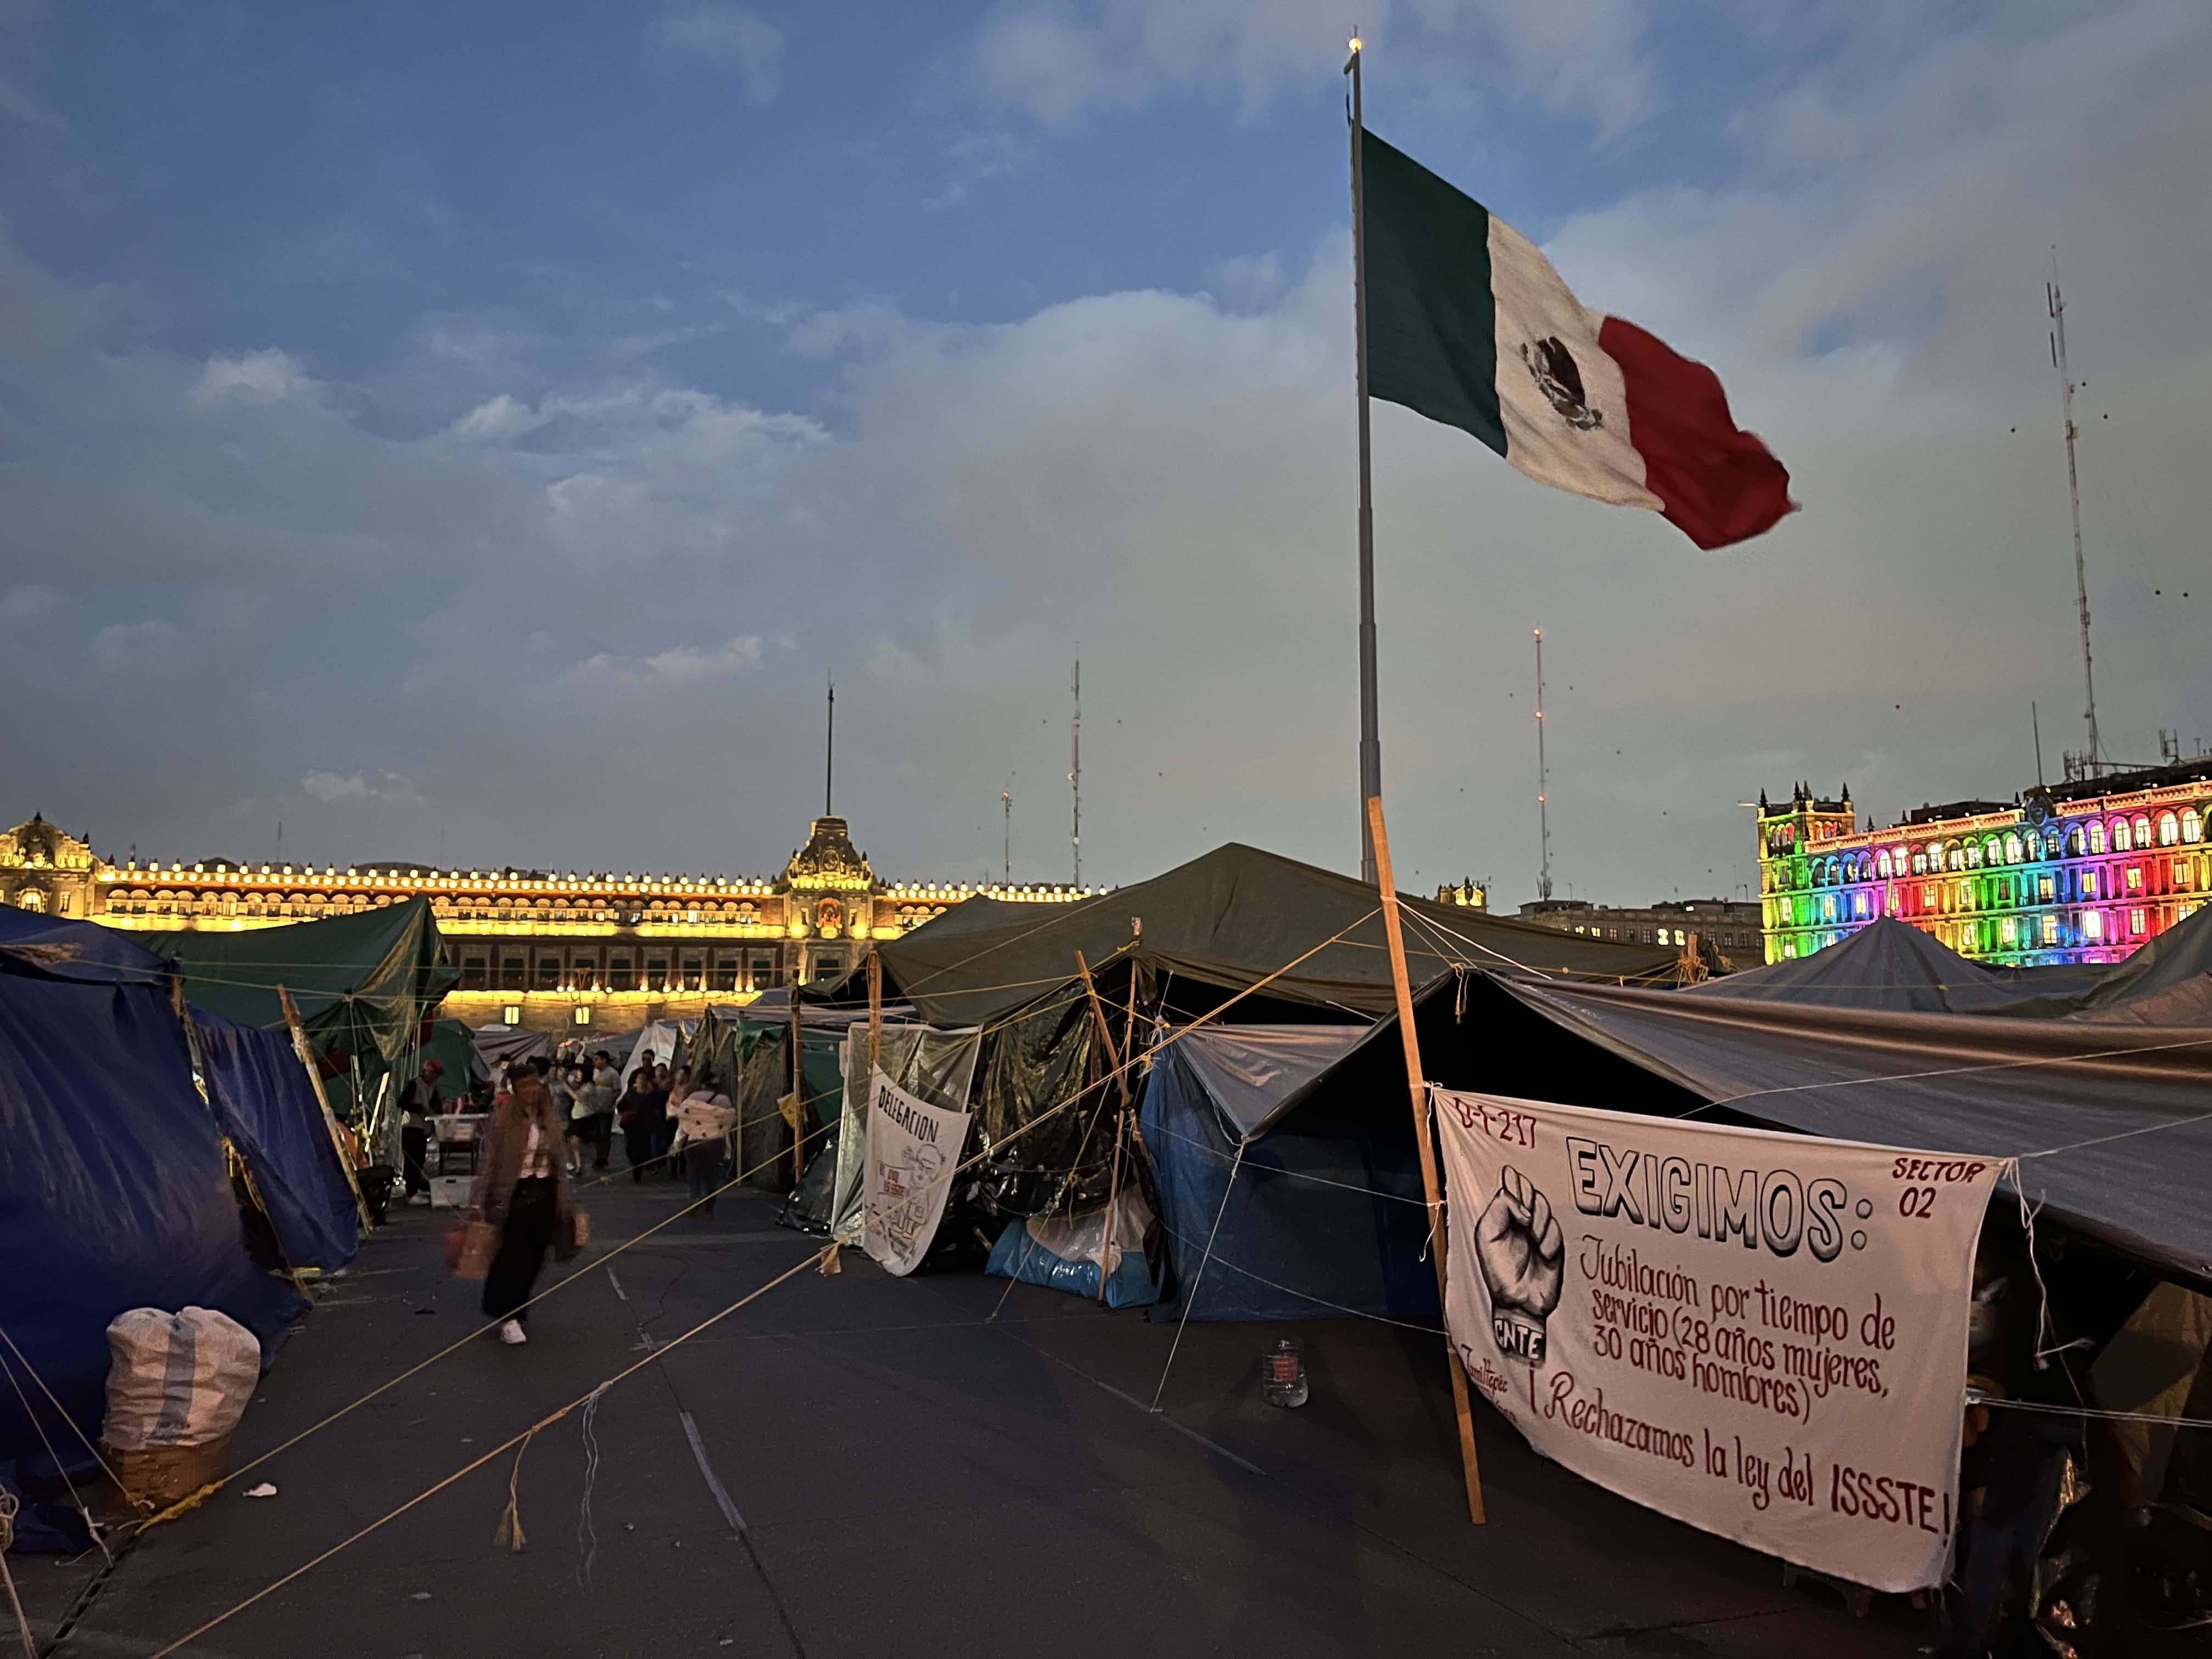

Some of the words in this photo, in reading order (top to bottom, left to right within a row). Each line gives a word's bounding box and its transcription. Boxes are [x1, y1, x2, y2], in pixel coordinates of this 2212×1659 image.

[878, 1085, 939, 1143] DELEGACION
[1566, 1136, 1873, 1263] EXIGIMOS:
[1892, 1158, 1987, 1183] SECTOR
[1899, 1187, 1937, 1218] 02
[1580, 1234, 1700, 1306] Jubilación
[1711, 1284, 1750, 1324] por
[1754, 1279, 1848, 1346] tiempo
[1861, 1293, 1895, 1351] de
[1494, 1320, 1543, 1359] CNTE
[1592, 1289, 1668, 1339] servicio
[1715, 1327, 1775, 1370] años
[1783, 1344, 1888, 1398] mujeres,
[1593, 1324, 1622, 1360] 30
[1630, 1338, 1686, 1381] años
[1692, 1353, 1810, 1426] hombres)
[1705, 1428, 1727, 1478] la
[1735, 1436, 1770, 1511] ley
[1778, 1447, 1814, 1506] del
